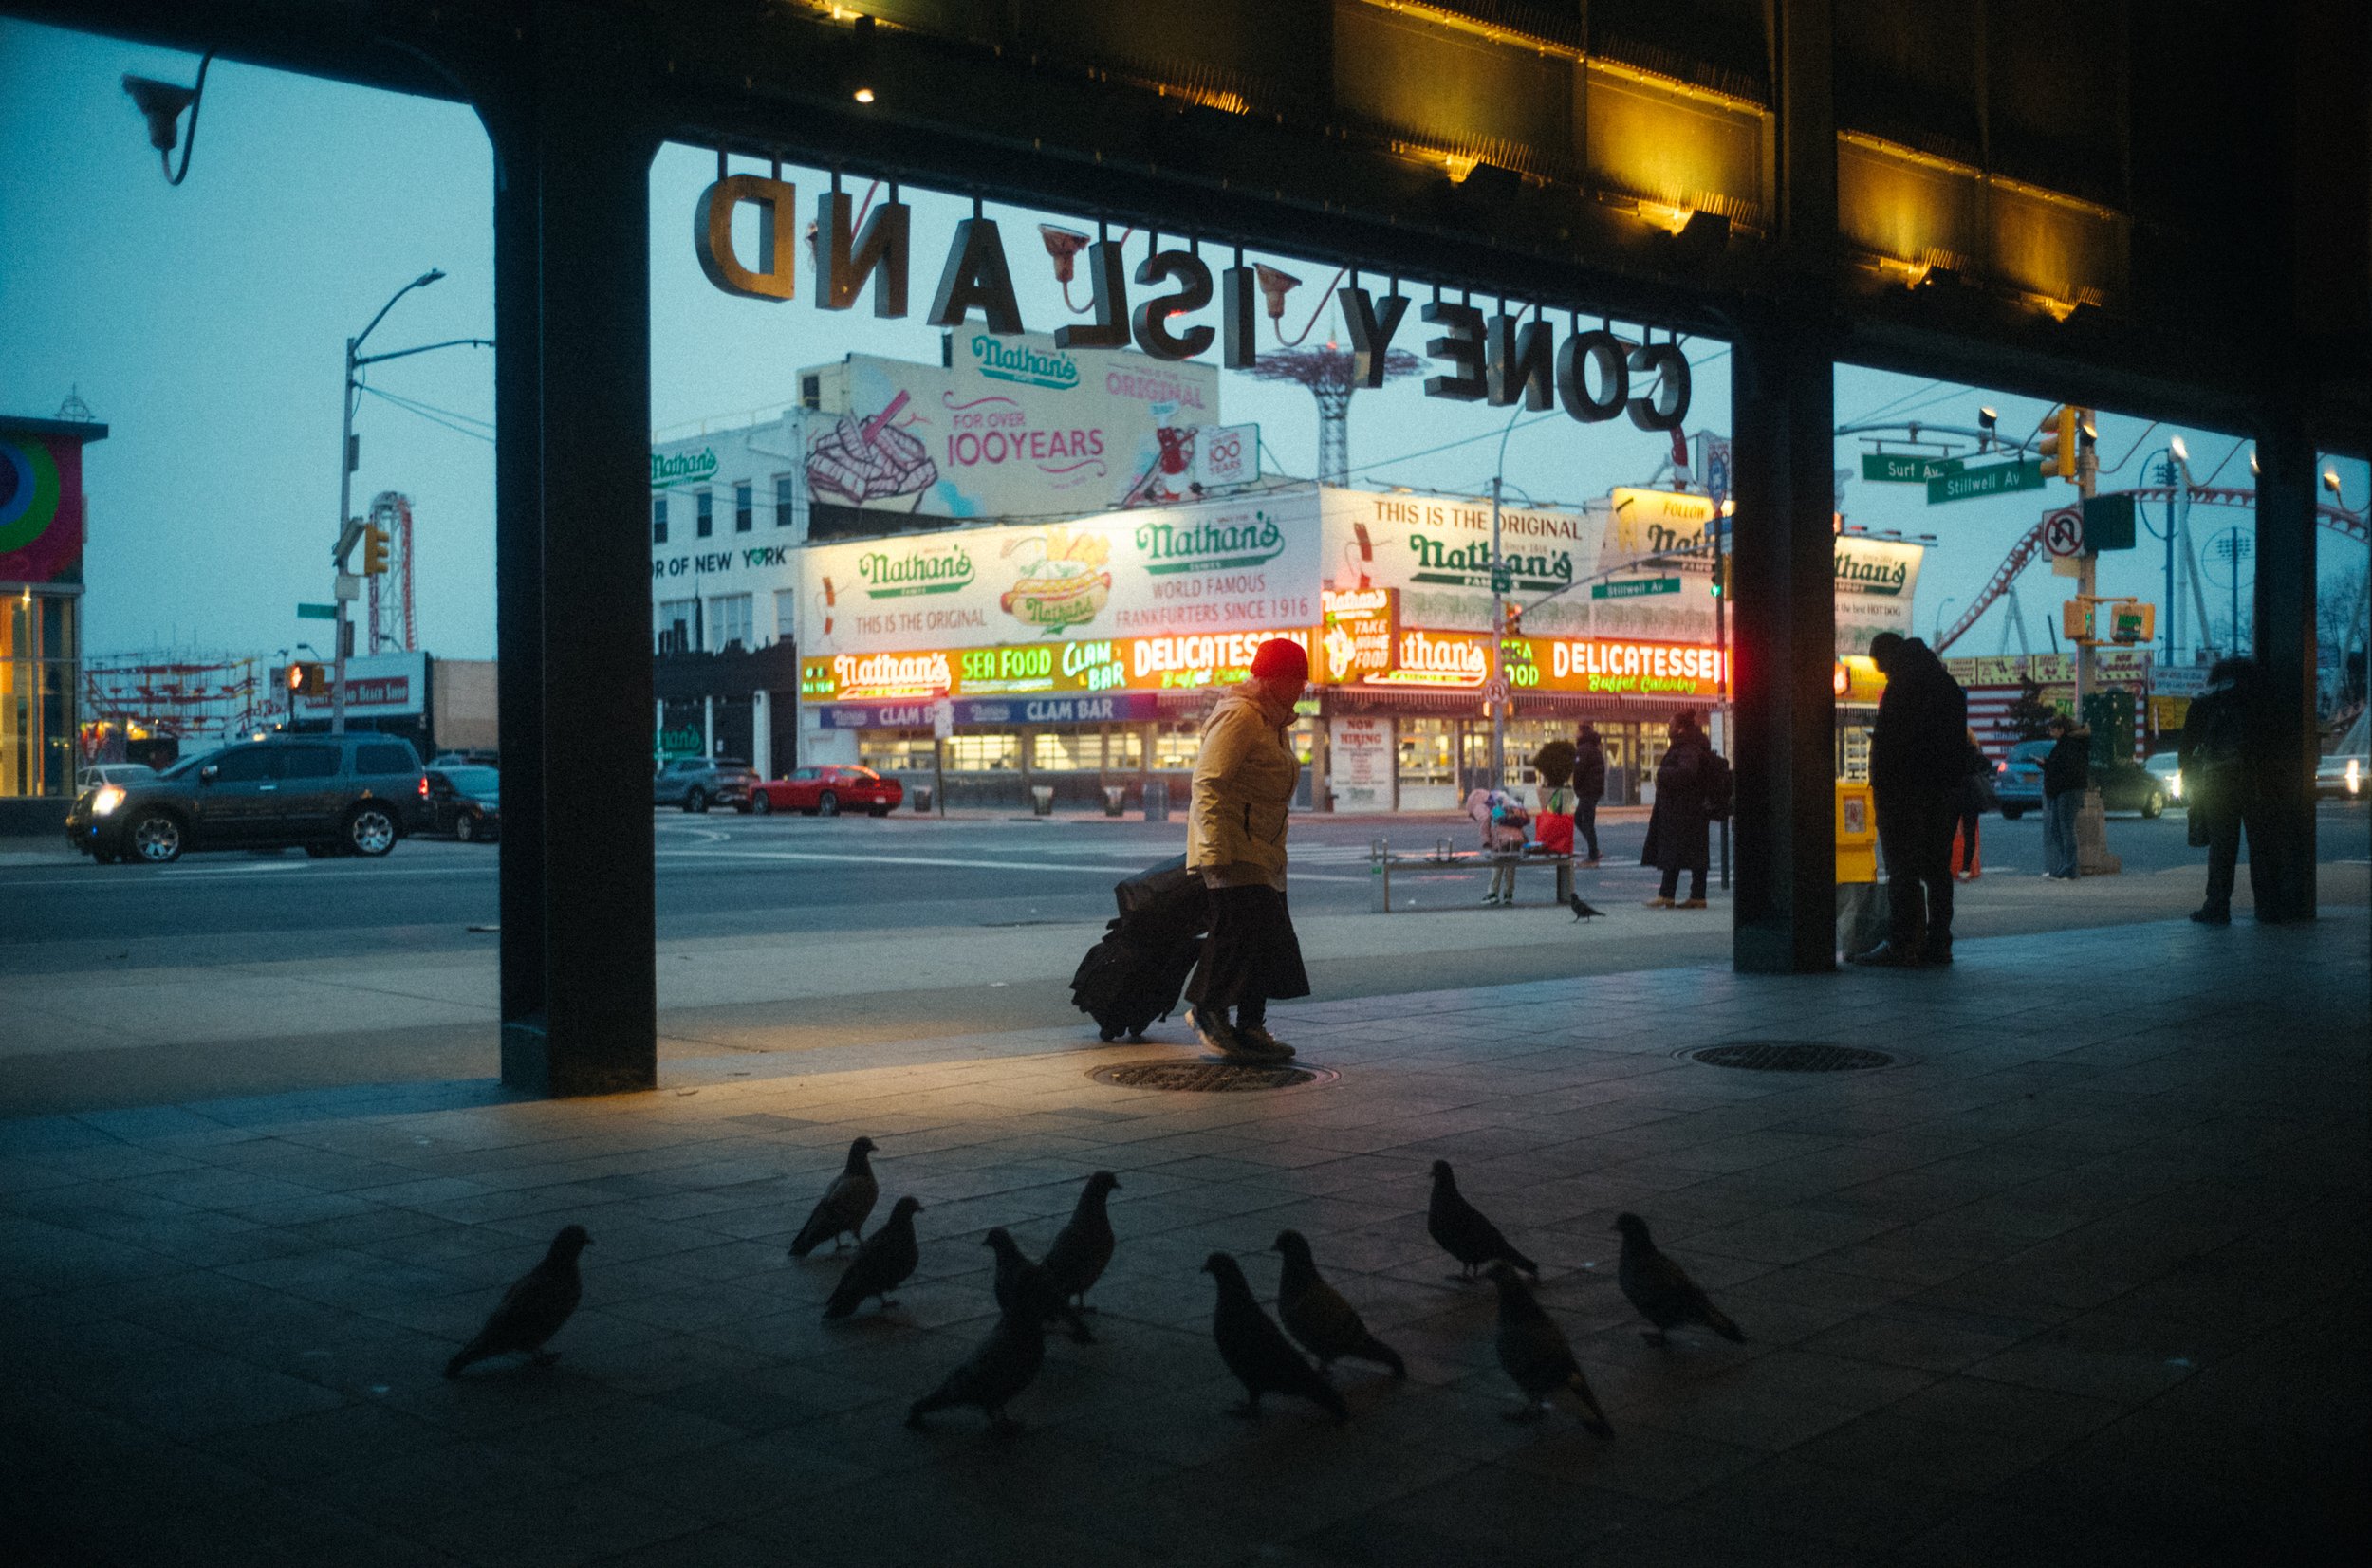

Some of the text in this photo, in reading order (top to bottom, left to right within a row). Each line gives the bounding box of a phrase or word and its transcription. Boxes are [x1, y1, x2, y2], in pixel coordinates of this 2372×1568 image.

[972, 335, 1078, 380] Nathan's
[1105, 371, 1206, 410] ORIGINAL
[954, 412, 1026, 429] FOR OVER
[1888, 461, 1939, 477] Surf Av
[1947, 471, 2020, 495] Stillwell Av
[1374, 500, 1419, 525] THIS
[1426, 506, 1444, 526] IS
[1452, 507, 1487, 531] THE
[1664, 501, 1706, 520] FOLLOW
[1136, 510, 1281, 559] Nathan's
[669, 557, 689, 577] OF
[695, 552, 732, 573] NEW
[742, 547, 787, 569] YRK
[859, 544, 972, 584] Nathan's
[1410, 533, 1573, 580] Nathan's
[1835, 552, 1907, 583] than's
[1152, 574, 1266, 600] WORLD FAMOUS
[1606, 581, 1664, 598] Stillwell Av
[857, 609, 988, 635] THIS IS THE ORIGINAL
[1116, 602, 1219, 628] FRANKFURTERS
[1224, 600, 1265, 621] SINCE
[1271, 597, 1309, 618] 1916
[1354, 618, 1388, 635] TAKE
[961, 647, 1052, 680] SEA FOOD
[1062, 641, 1111, 677] CLAM
[1134, 631, 1308, 678] DELICATESN
[1354, 650, 1389, 669] FOOD
[1399, 632, 1486, 672] than's
[1553, 641, 1729, 684] DELICATESSEN
[834, 652, 951, 688] Nathan's
[1088, 661, 1127, 692] BAR
[1503, 664, 1539, 686] OOD
[1587, 673, 1696, 695] Buffet Catering
[879, 706, 920, 725] CLAM
[1026, 701, 1073, 722] CLAM
[1077, 699, 1114, 720] BAR
[1347, 717, 1375, 729] NOW
[1340, 732, 1382, 745] HIRING
